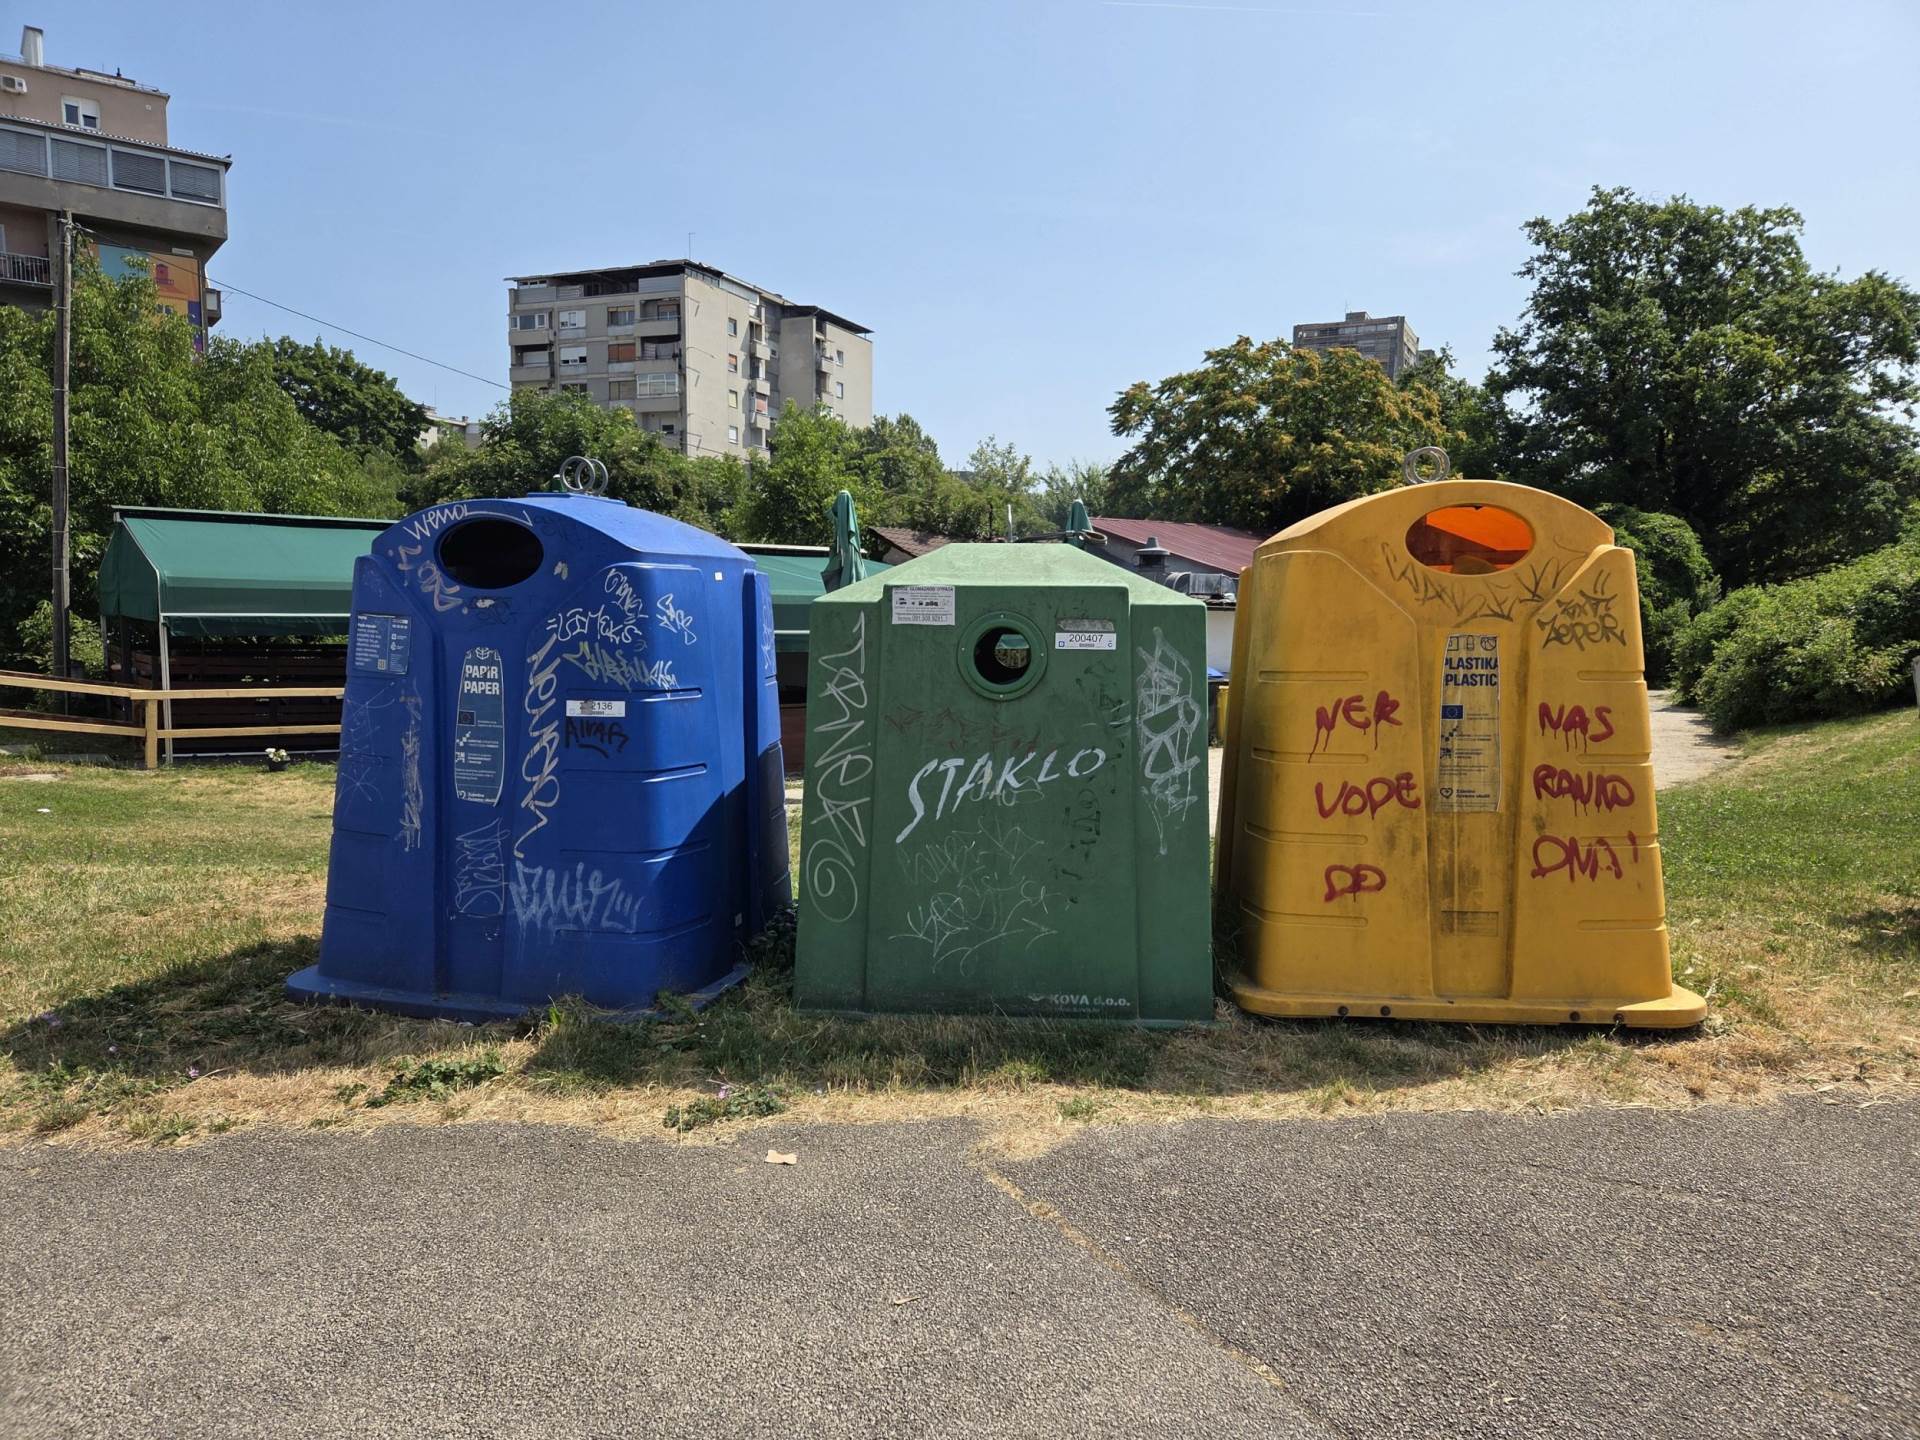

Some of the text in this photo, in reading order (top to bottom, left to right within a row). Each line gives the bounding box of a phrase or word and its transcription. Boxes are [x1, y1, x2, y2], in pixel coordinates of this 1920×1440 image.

[1069, 633, 1104, 643] 200407
[465, 664, 499, 679] PAPIR
[1445, 674, 1497, 687] PLASTIC
[464, 681, 500, 695] PAPER
[579, 702, 613, 711] 2136
[1538, 702, 1615, 748] NAS
[896, 748, 1106, 843] STAKLO
[1051, 994, 1130, 1006] KOVA d.o.o.
